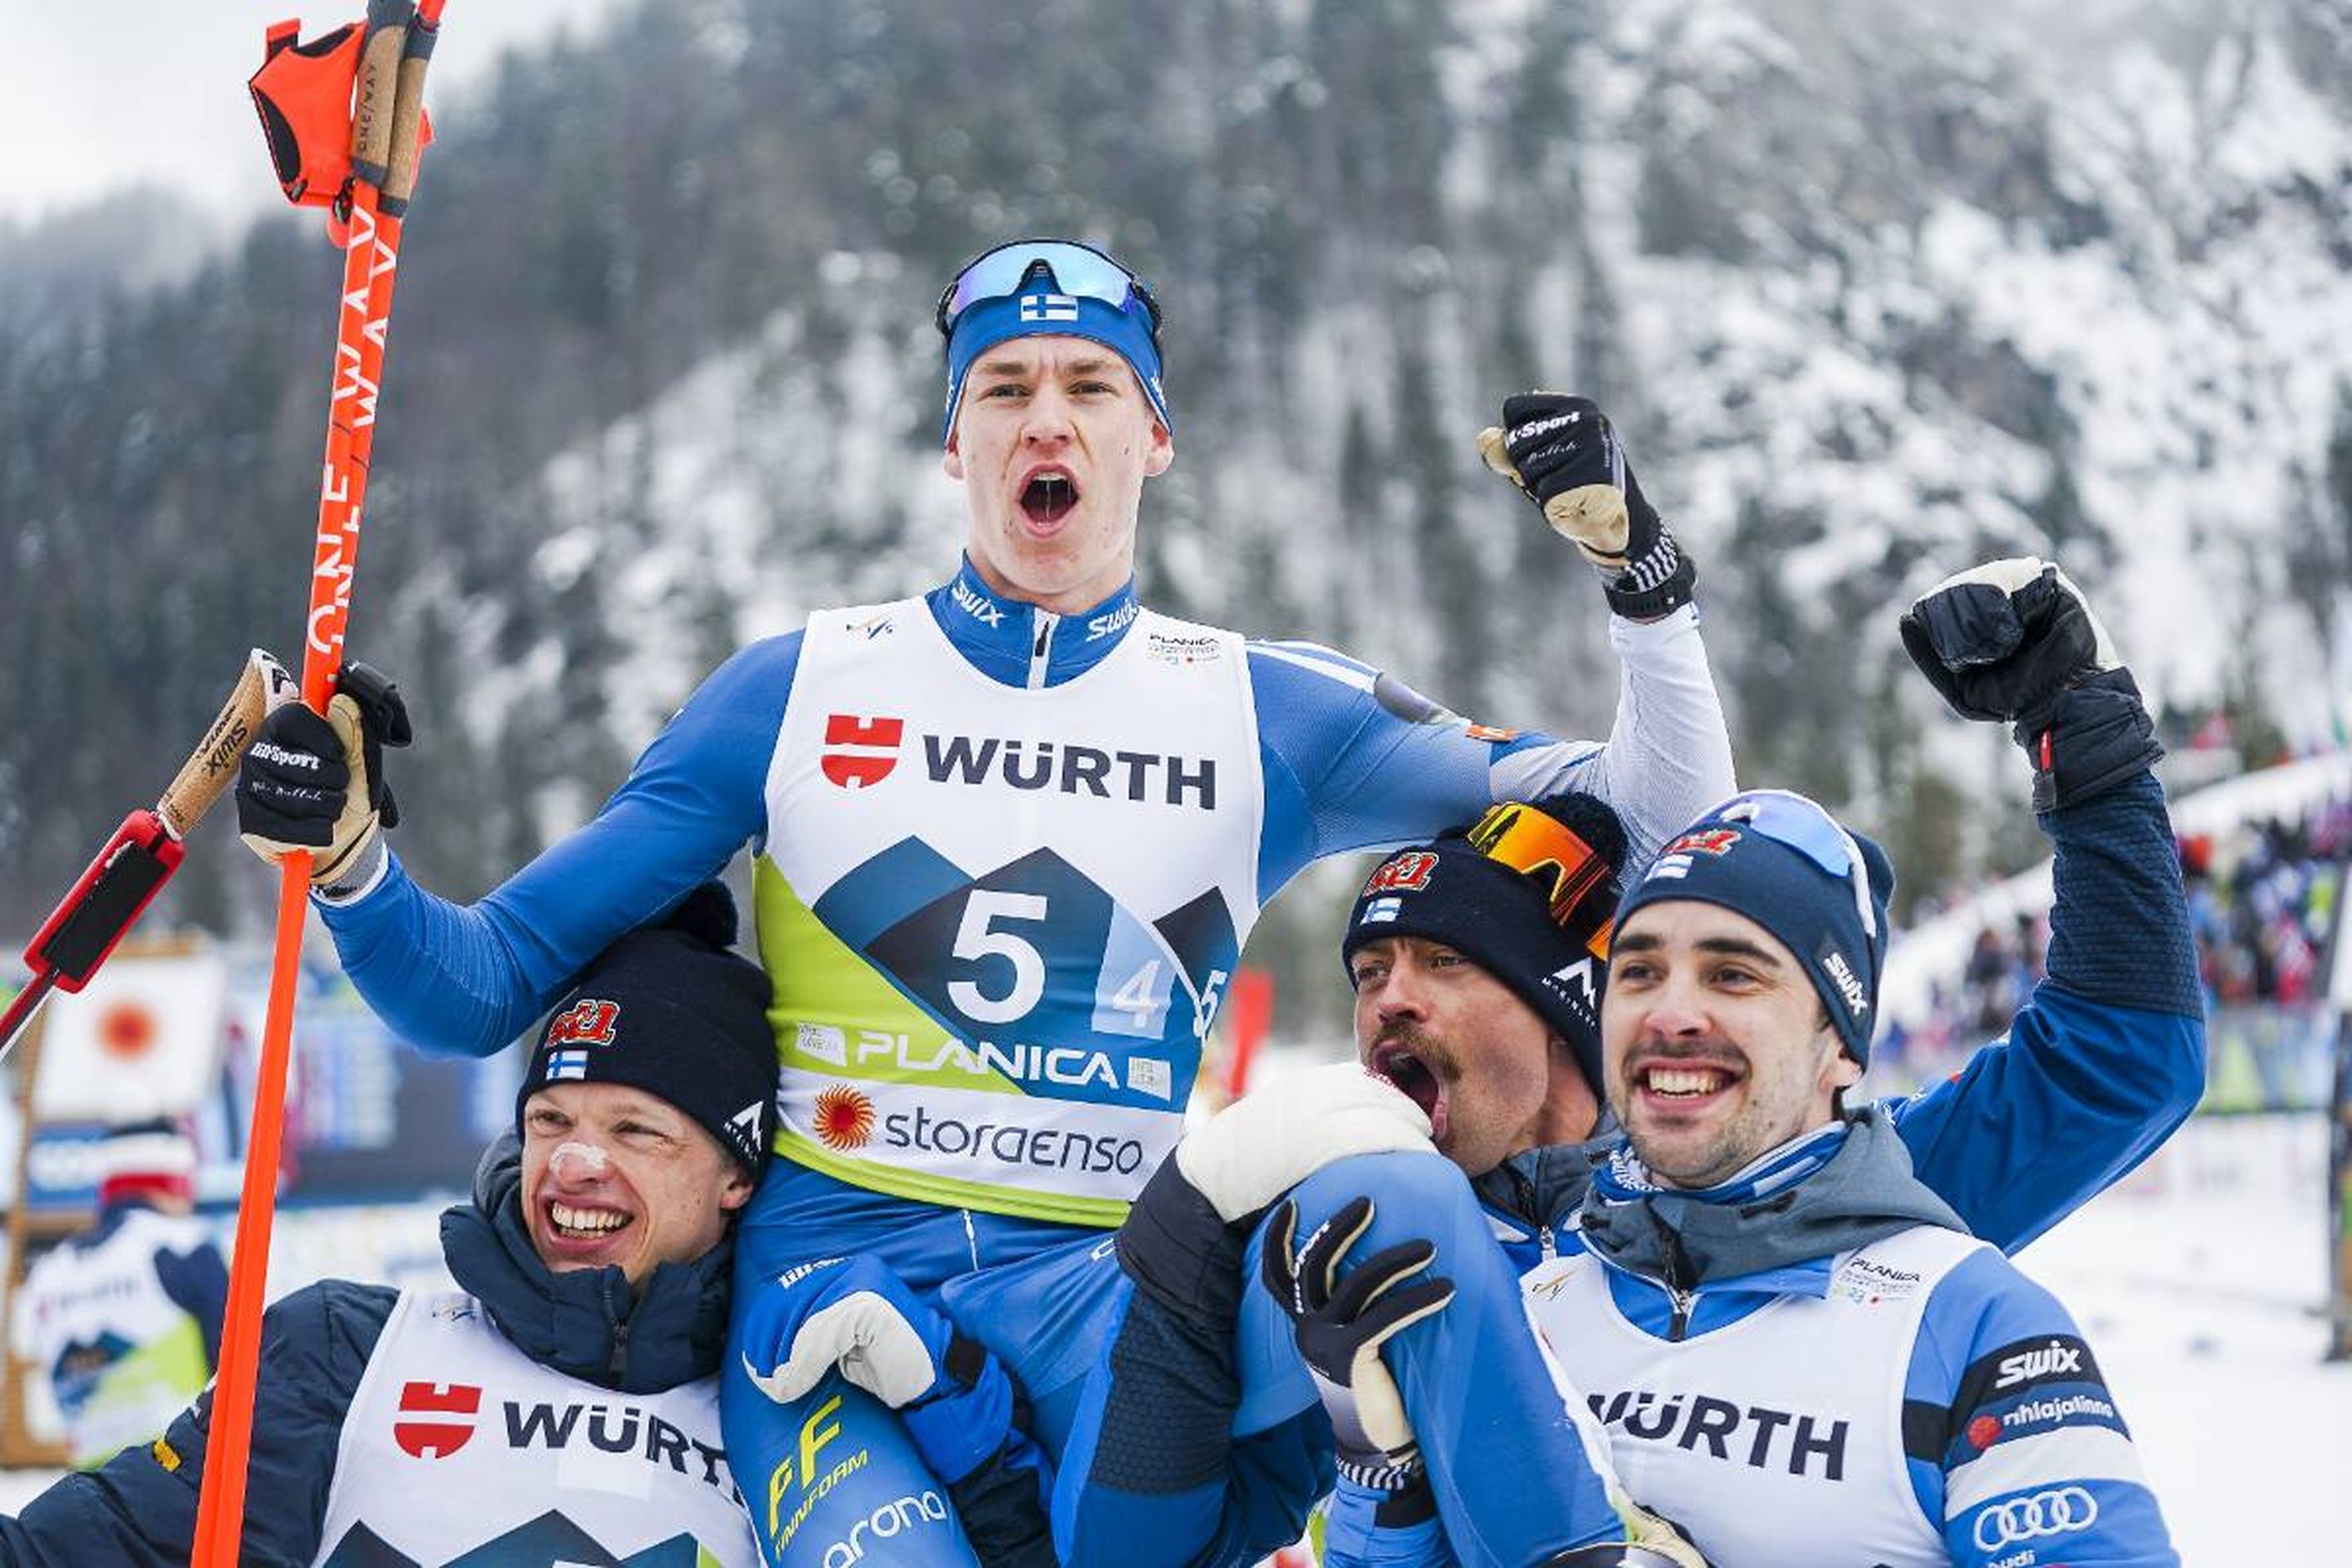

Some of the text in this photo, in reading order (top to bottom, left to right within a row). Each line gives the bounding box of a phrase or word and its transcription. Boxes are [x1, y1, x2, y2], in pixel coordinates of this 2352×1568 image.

[922, 734, 1217, 812] WÜRTH
[947, 889, 1047, 1022] 5
[1112, 960, 1161, 1028] 4
[857, 1030, 1120, 1090] PLANICA
[885, 1107, 1143, 1174] storaenso
[1850, 1258, 1920, 1283] PLANICA
[503, 1399, 745, 1508] WÜRT
